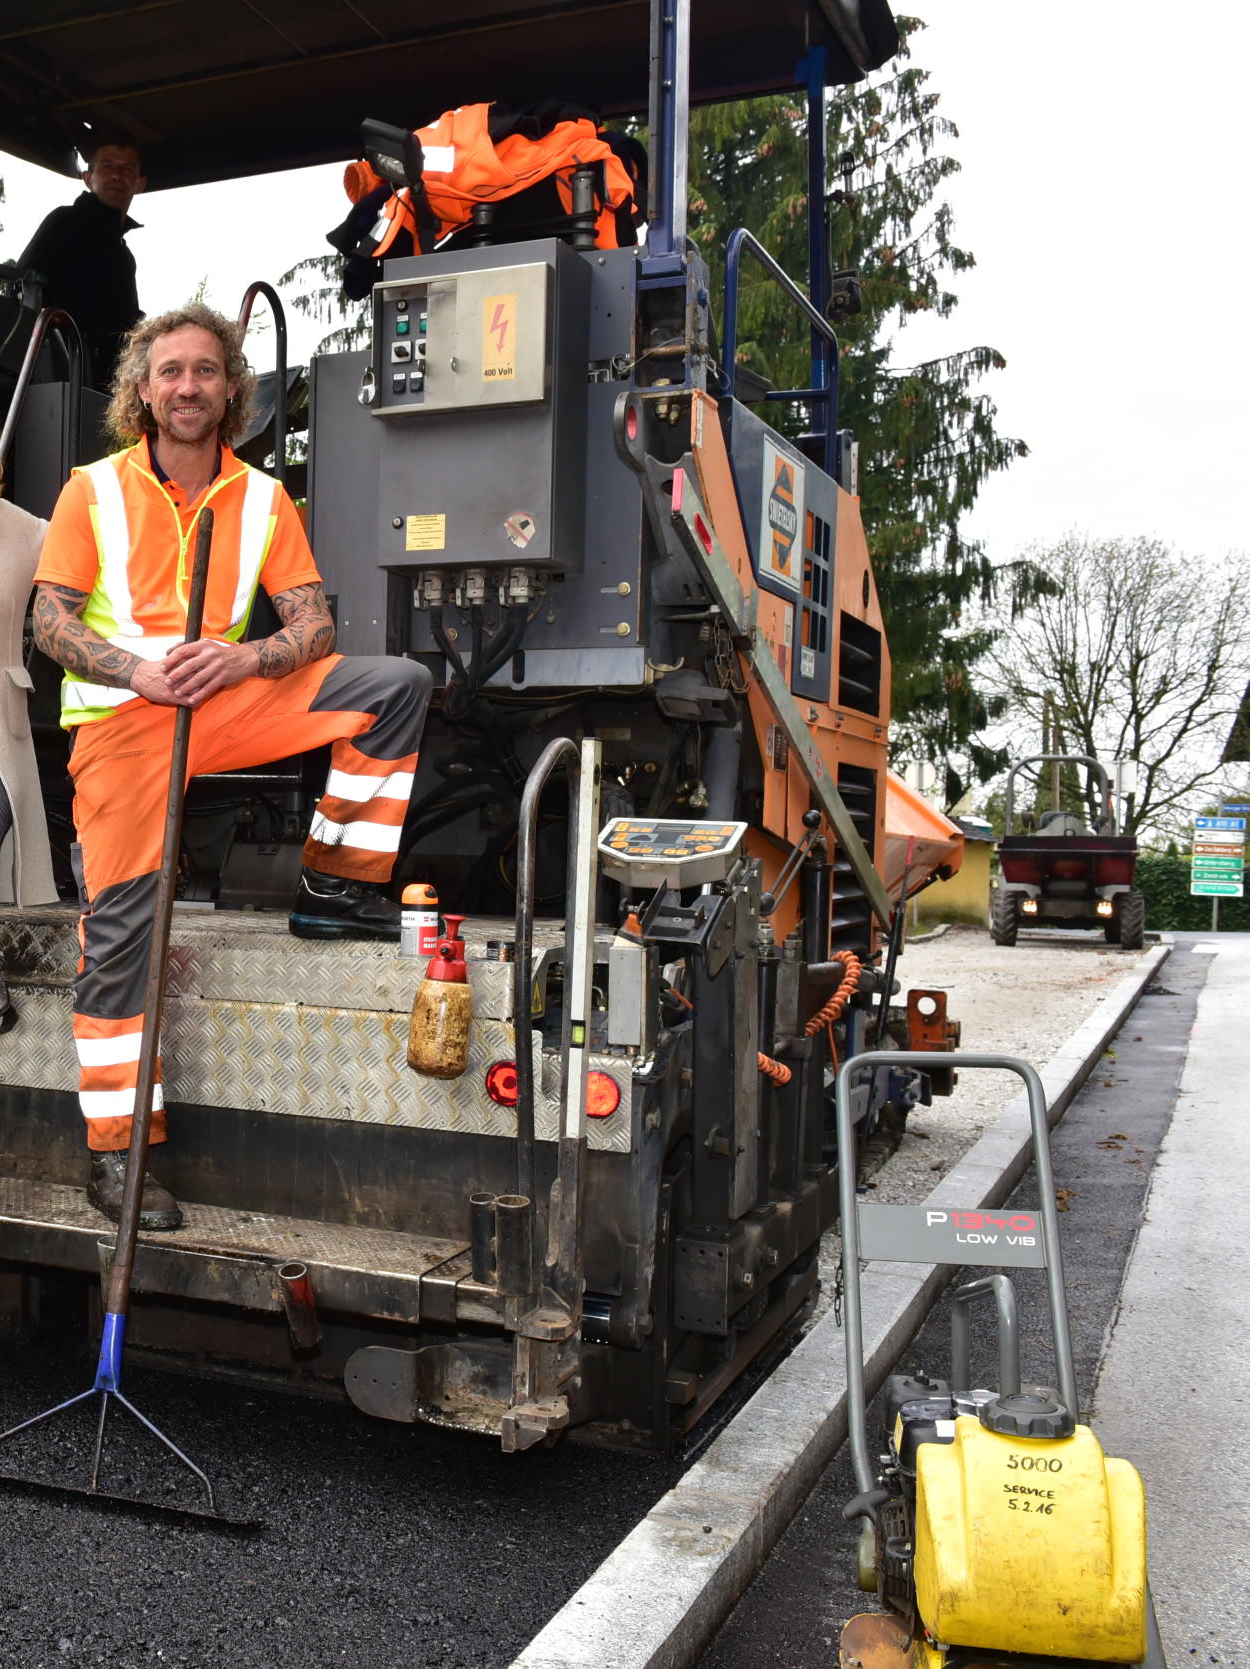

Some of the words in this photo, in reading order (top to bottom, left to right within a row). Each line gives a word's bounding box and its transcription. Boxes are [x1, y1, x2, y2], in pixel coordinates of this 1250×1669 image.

[484, 368, 496, 376] 400
[498, 367, 513, 376] Volt
[926, 1211, 1036, 1231] P1340
[956, 1233, 998, 1245] LOW
[1006, 1235, 1036, 1246] VIB
[1006, 1454, 1063, 1472] 5000
[1003, 1484, 1055, 1499] SERVICE
